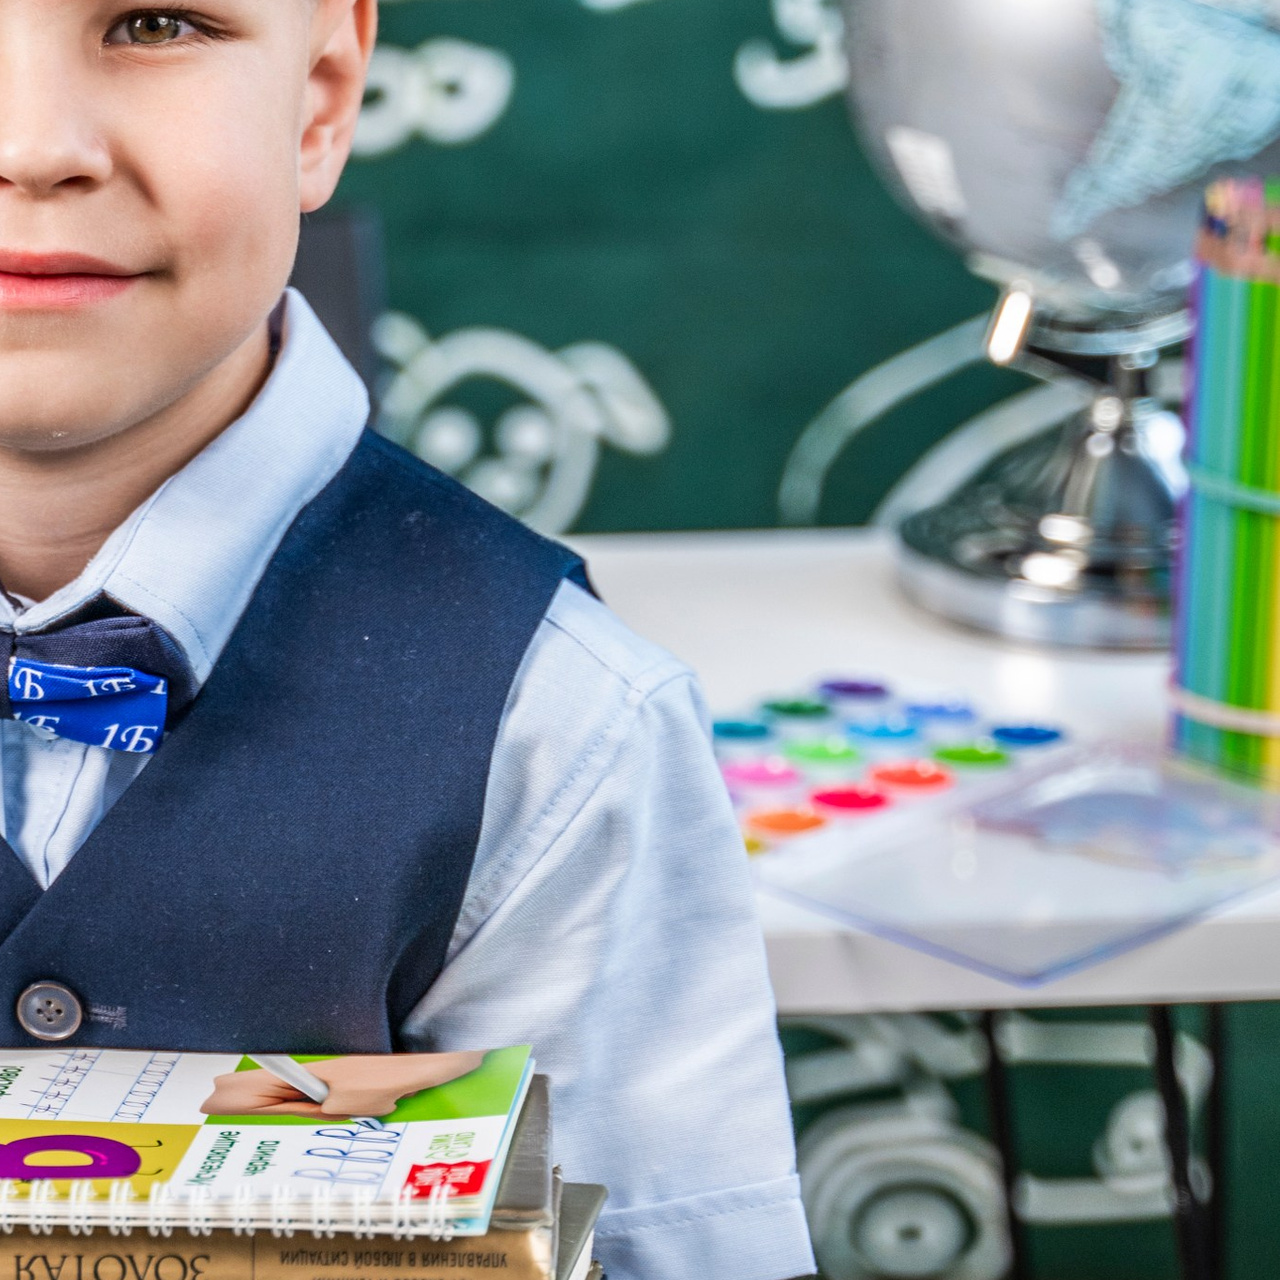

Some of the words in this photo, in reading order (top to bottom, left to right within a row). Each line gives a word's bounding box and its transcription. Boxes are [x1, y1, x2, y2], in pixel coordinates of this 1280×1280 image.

[100, 723, 159, 753] 1Б
[184, 1130, 241, 1187] Исчезающие
[243, 1140, 281, 1177] чернила
[280, 1248, 348, 1267] СИТУАЦИИ
[354, 1251, 404, 1269] ЛЮБОЙ
[408, 1251, 416, 1267] В
[422, 1251, 508, 1269] УПРАВЛЕНИЯ
